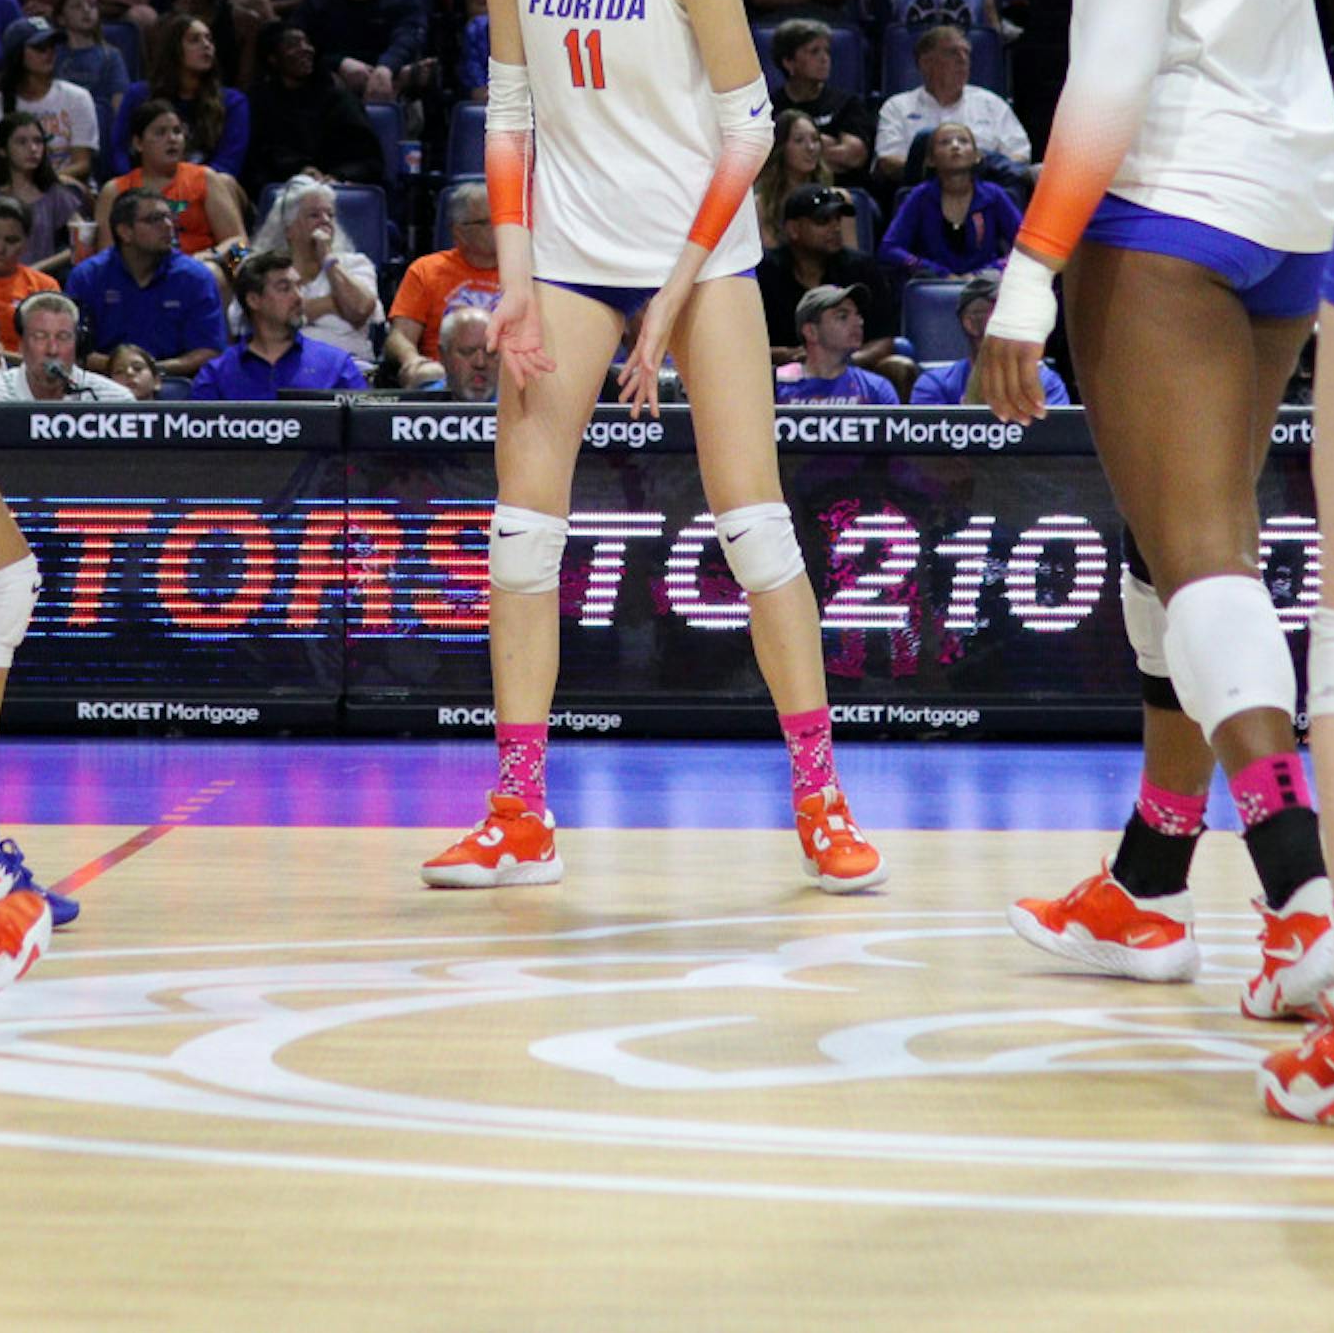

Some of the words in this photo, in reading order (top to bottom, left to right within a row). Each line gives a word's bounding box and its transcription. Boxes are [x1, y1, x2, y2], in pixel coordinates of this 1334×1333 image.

[564, 28, 606, 89] 11
[30, 414, 158, 440] ROCKET
[392, 416, 497, 442] ROCKE
[775, 417, 877, 443] OCKET
[885, 416, 1023, 449] Mortgage
[77, 702, 164, 721] ROCKET
[167, 703, 260, 725] Mortgage
[438, 707, 496, 726] ROCK
[548, 709, 622, 730] ortgage
[830, 705, 884, 723] CKET
[886, 706, 980, 726] Mortgage
